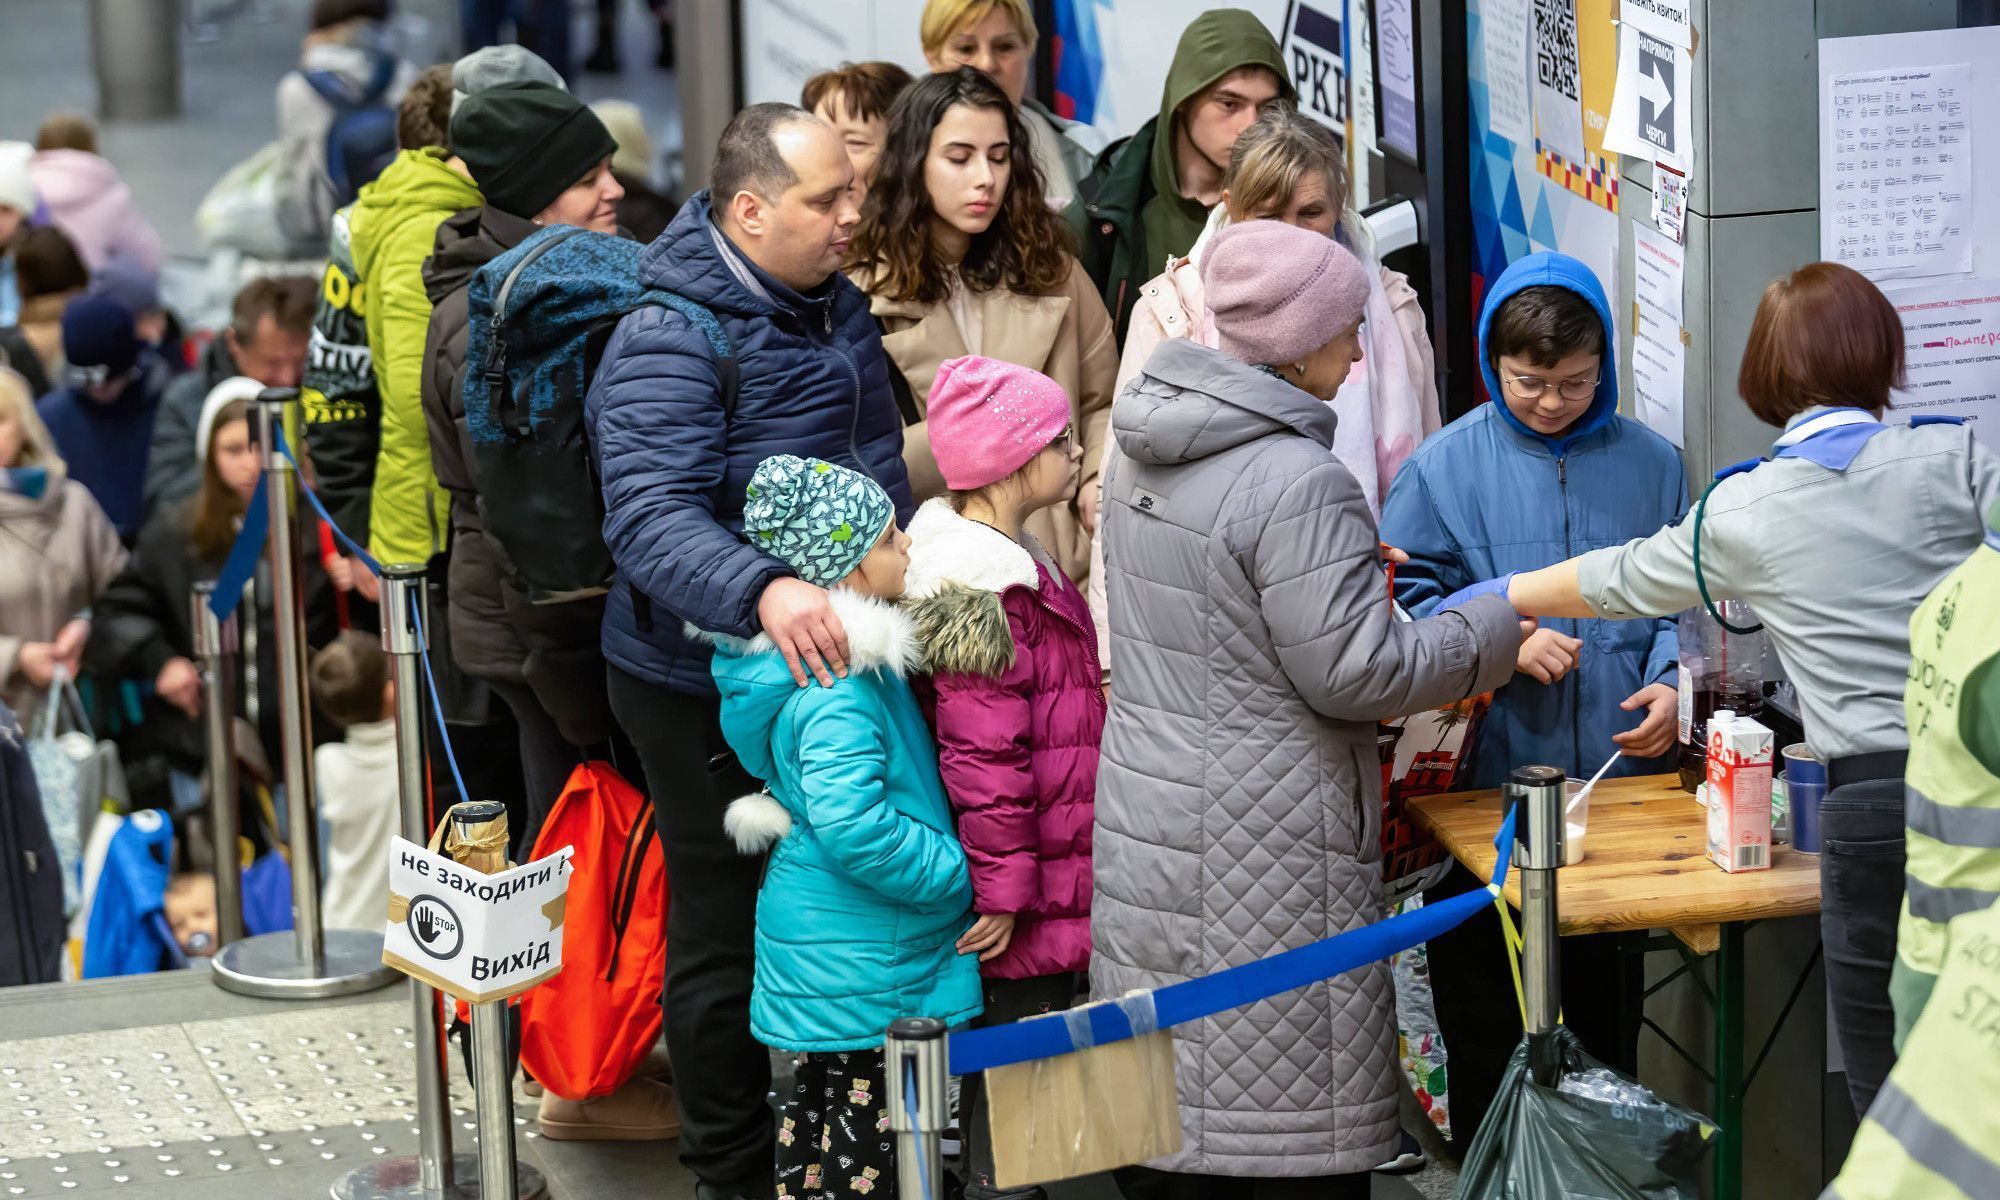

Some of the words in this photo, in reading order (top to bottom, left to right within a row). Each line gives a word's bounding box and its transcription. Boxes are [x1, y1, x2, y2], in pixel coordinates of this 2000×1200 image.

[1638, 34, 1674, 64] НАПРЯМОК
[1646, 123, 1667, 147] ЧЕРГИ
[401, 851, 430, 876] не
[436, 866, 551, 904] заходити
[558, 854, 565, 876] !
[434, 916, 456, 933] STOP
[471, 941, 551, 981] Вихід
